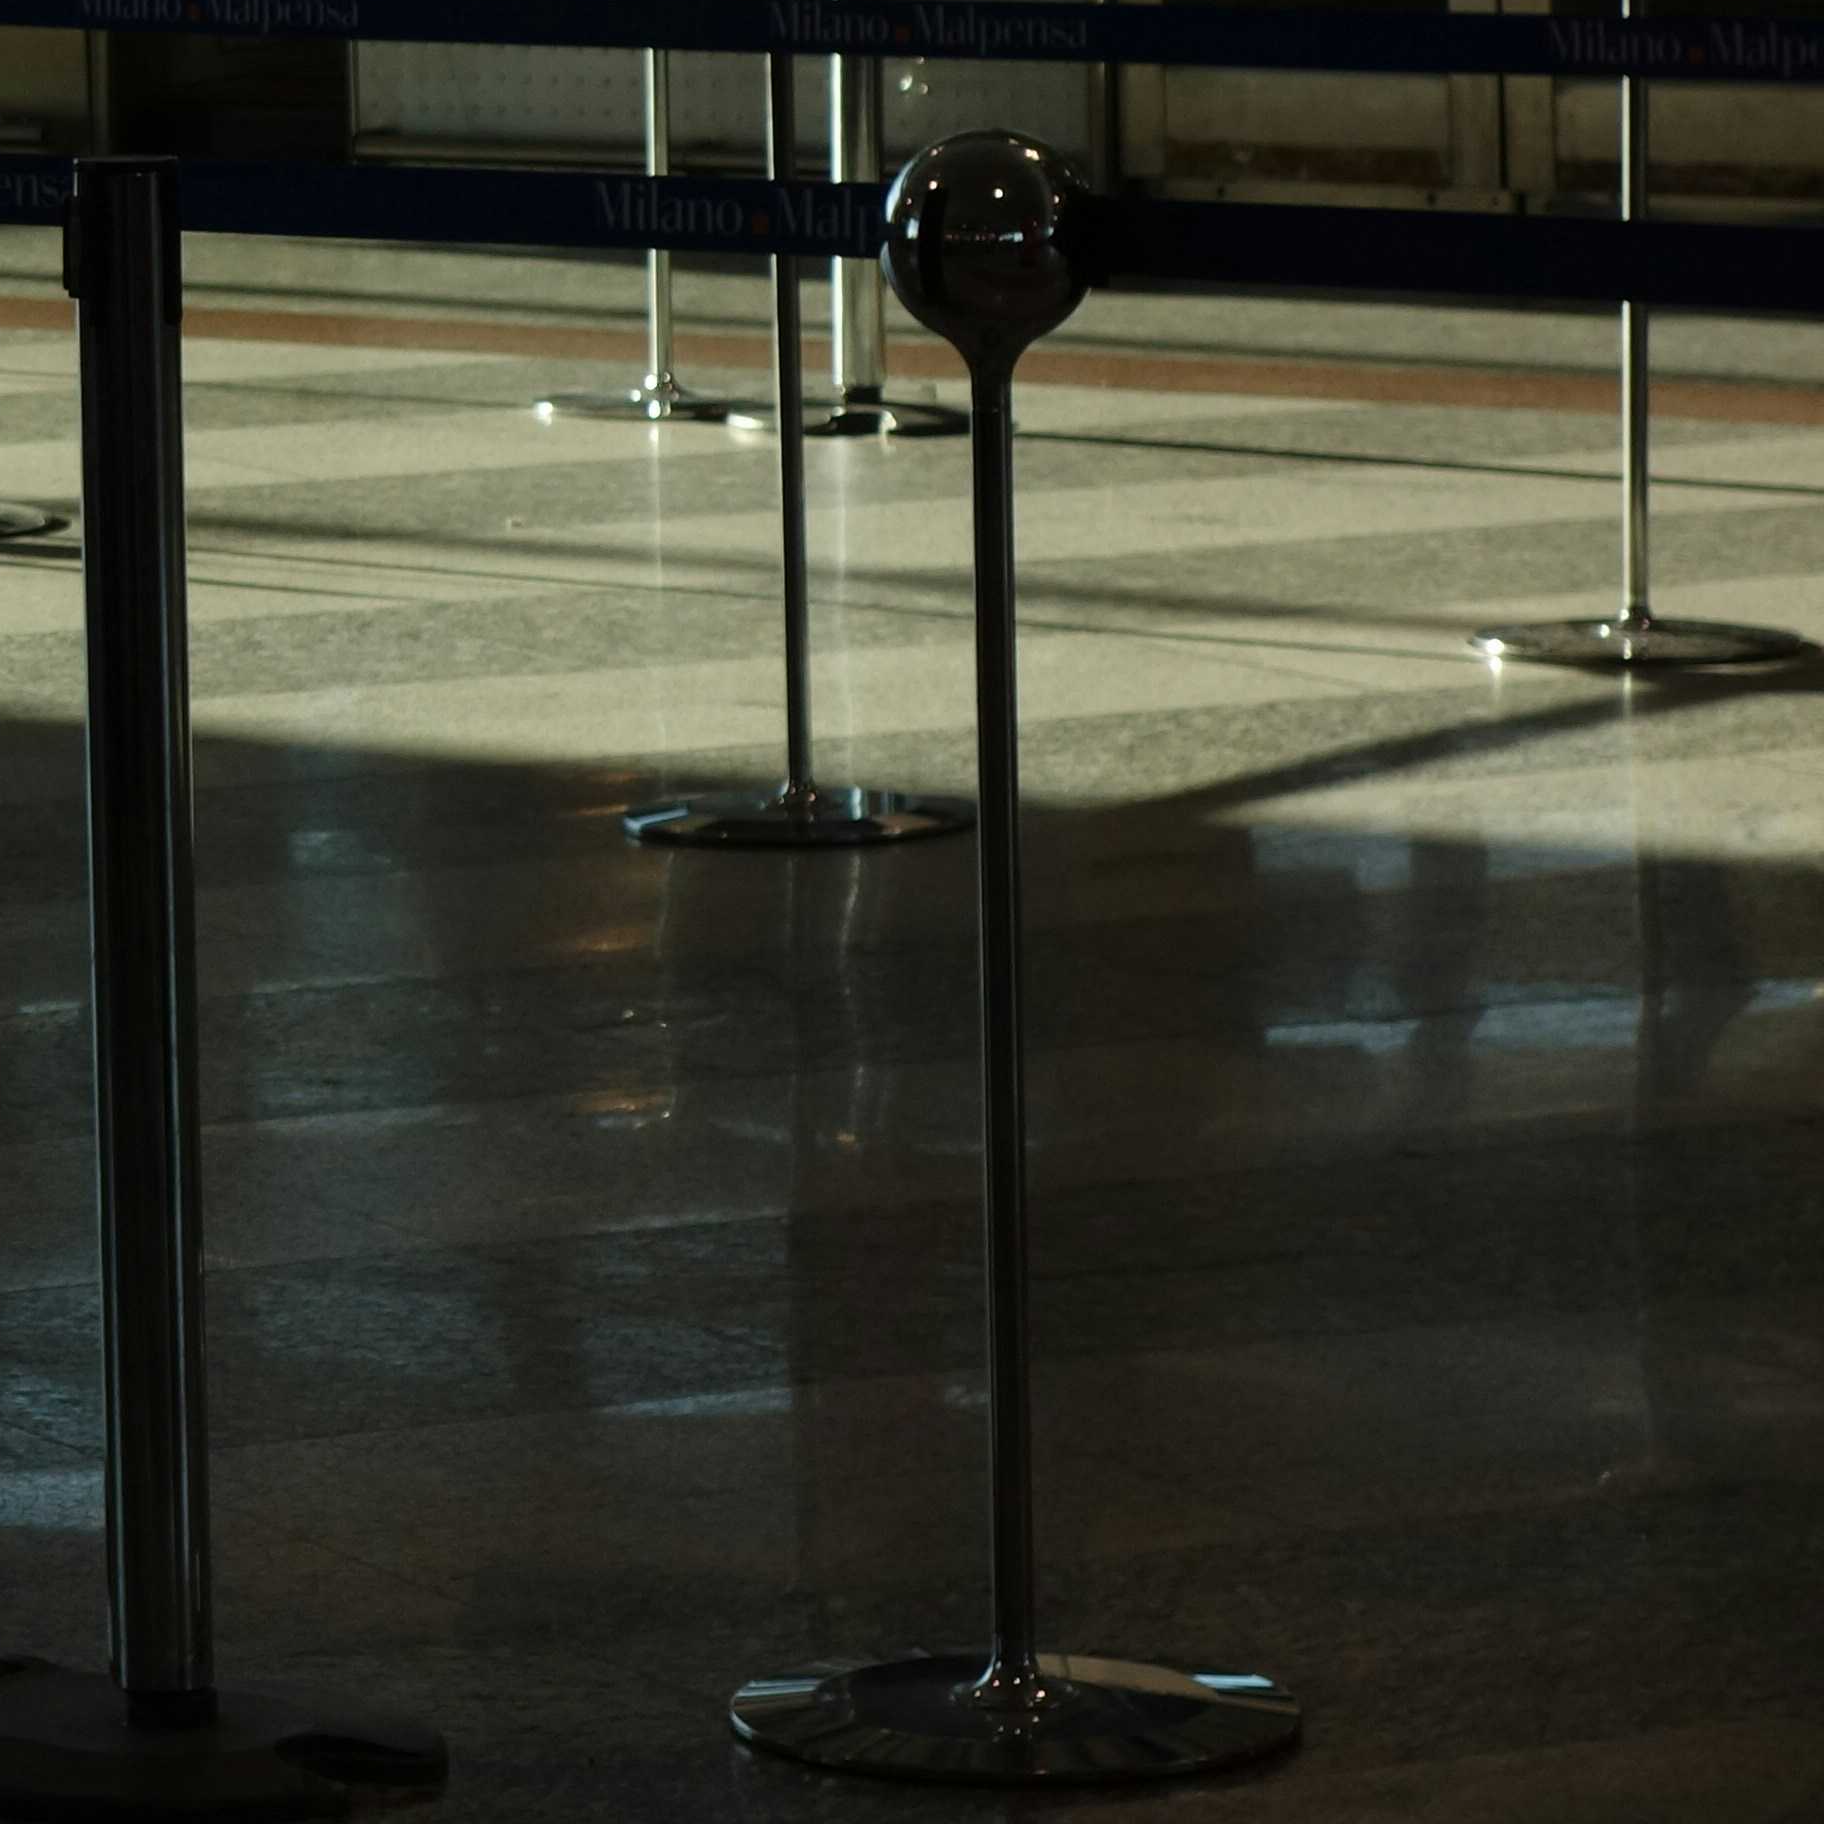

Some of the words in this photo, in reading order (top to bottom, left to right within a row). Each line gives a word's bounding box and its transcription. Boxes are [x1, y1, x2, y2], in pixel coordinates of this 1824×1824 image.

[769, 1, 889, 42] Milano
[909, 3, 1088, 57] Malpensa
[1545, 18, 1683, 64] Milano
[1708, 20, 1824, 79] Malpe
[593, 180, 745, 233] Milano
[776, 187, 885, 253] Malp
